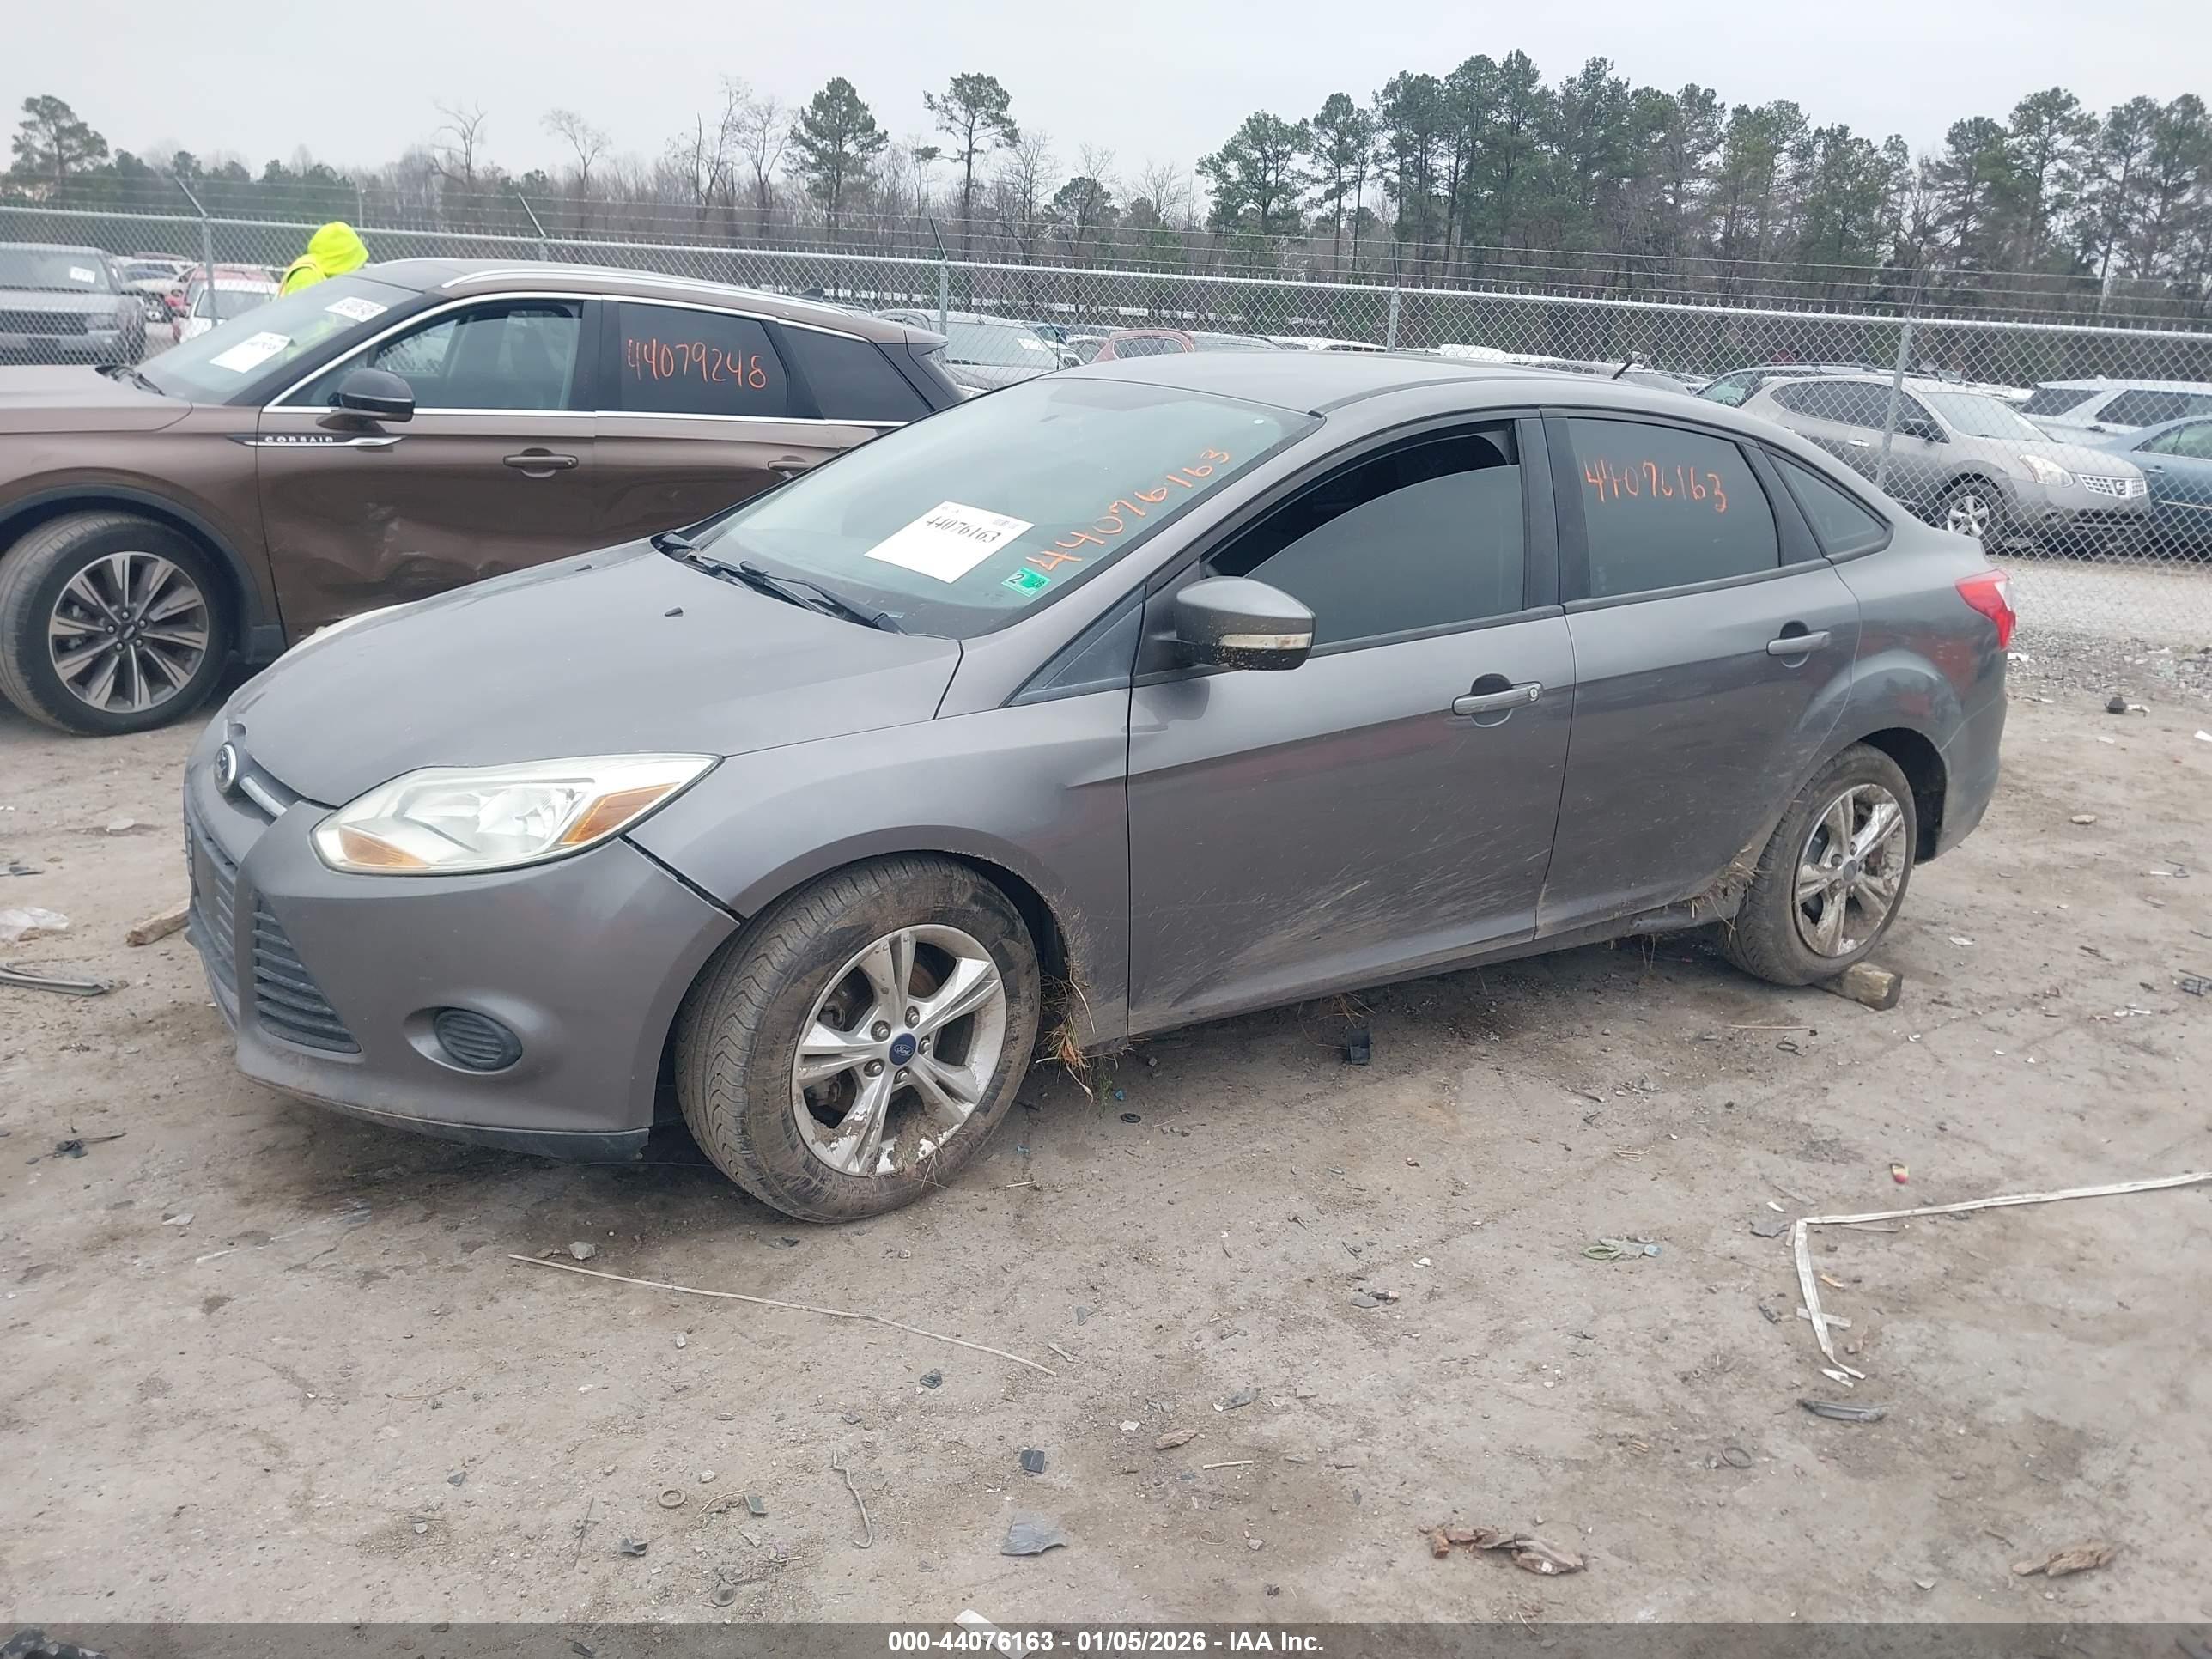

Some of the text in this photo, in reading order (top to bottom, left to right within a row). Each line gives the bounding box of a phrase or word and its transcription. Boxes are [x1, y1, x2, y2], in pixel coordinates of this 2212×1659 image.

[1025, 447, 1231, 572] 44076163
[926, 515, 1002, 544] 44076163
[1008, 573, 1024, 584] 2
